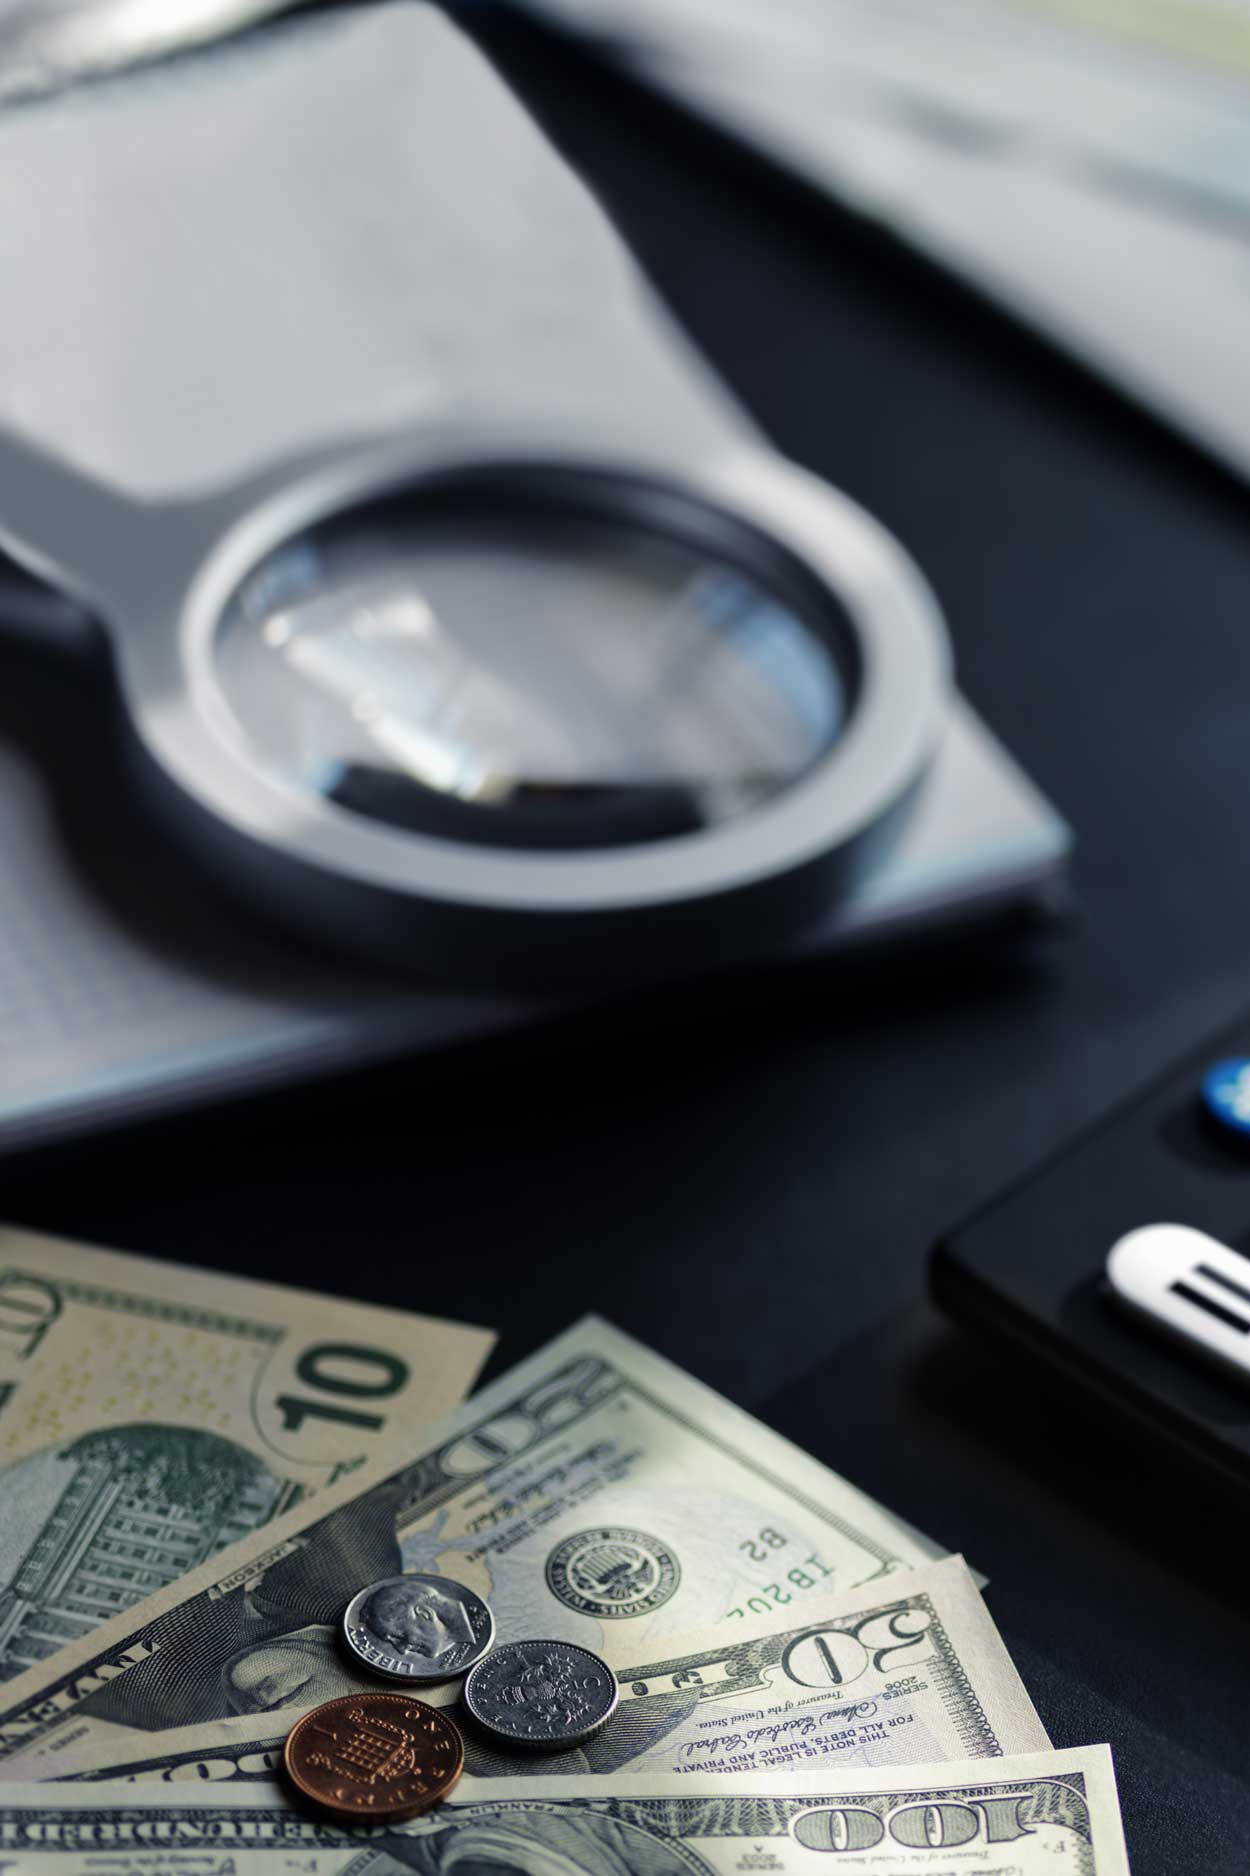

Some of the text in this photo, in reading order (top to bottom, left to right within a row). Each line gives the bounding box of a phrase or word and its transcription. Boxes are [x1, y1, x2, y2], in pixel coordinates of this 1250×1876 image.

[274, 1342, 411, 1432] 10
[739, 1526, 788, 1562] B2
[222, 1549, 287, 1589] JACKSON
[782, 1606, 932, 1688] 50
[881, 1681, 929, 1700] SERIES
[884, 1676, 917, 1690] 2006
[797, 1690, 844, 1706] Treasurer
[767, 1704, 781, 1715] the
[782, 1700, 795, 1713] of
[730, 1710, 765, 1725] United
[887, 1714, 914, 1727] FOR
[858, 1722, 883, 1734] ALL
[859, 1730, 890, 1745] THIS
[761, 1741, 808, 1755] PUBLIC
[804, 1746, 818, 1757] IS
[821, 1739, 855, 1754] NOTE
[672, 1758, 726, 1774] PRIVATE
[730, 1753, 755, 1765] AND
[765, 1750, 802, 1768] LEGAL
[470, 1803, 556, 1815] FRANKLIN
[793, 1793, 1037, 1852] 100
